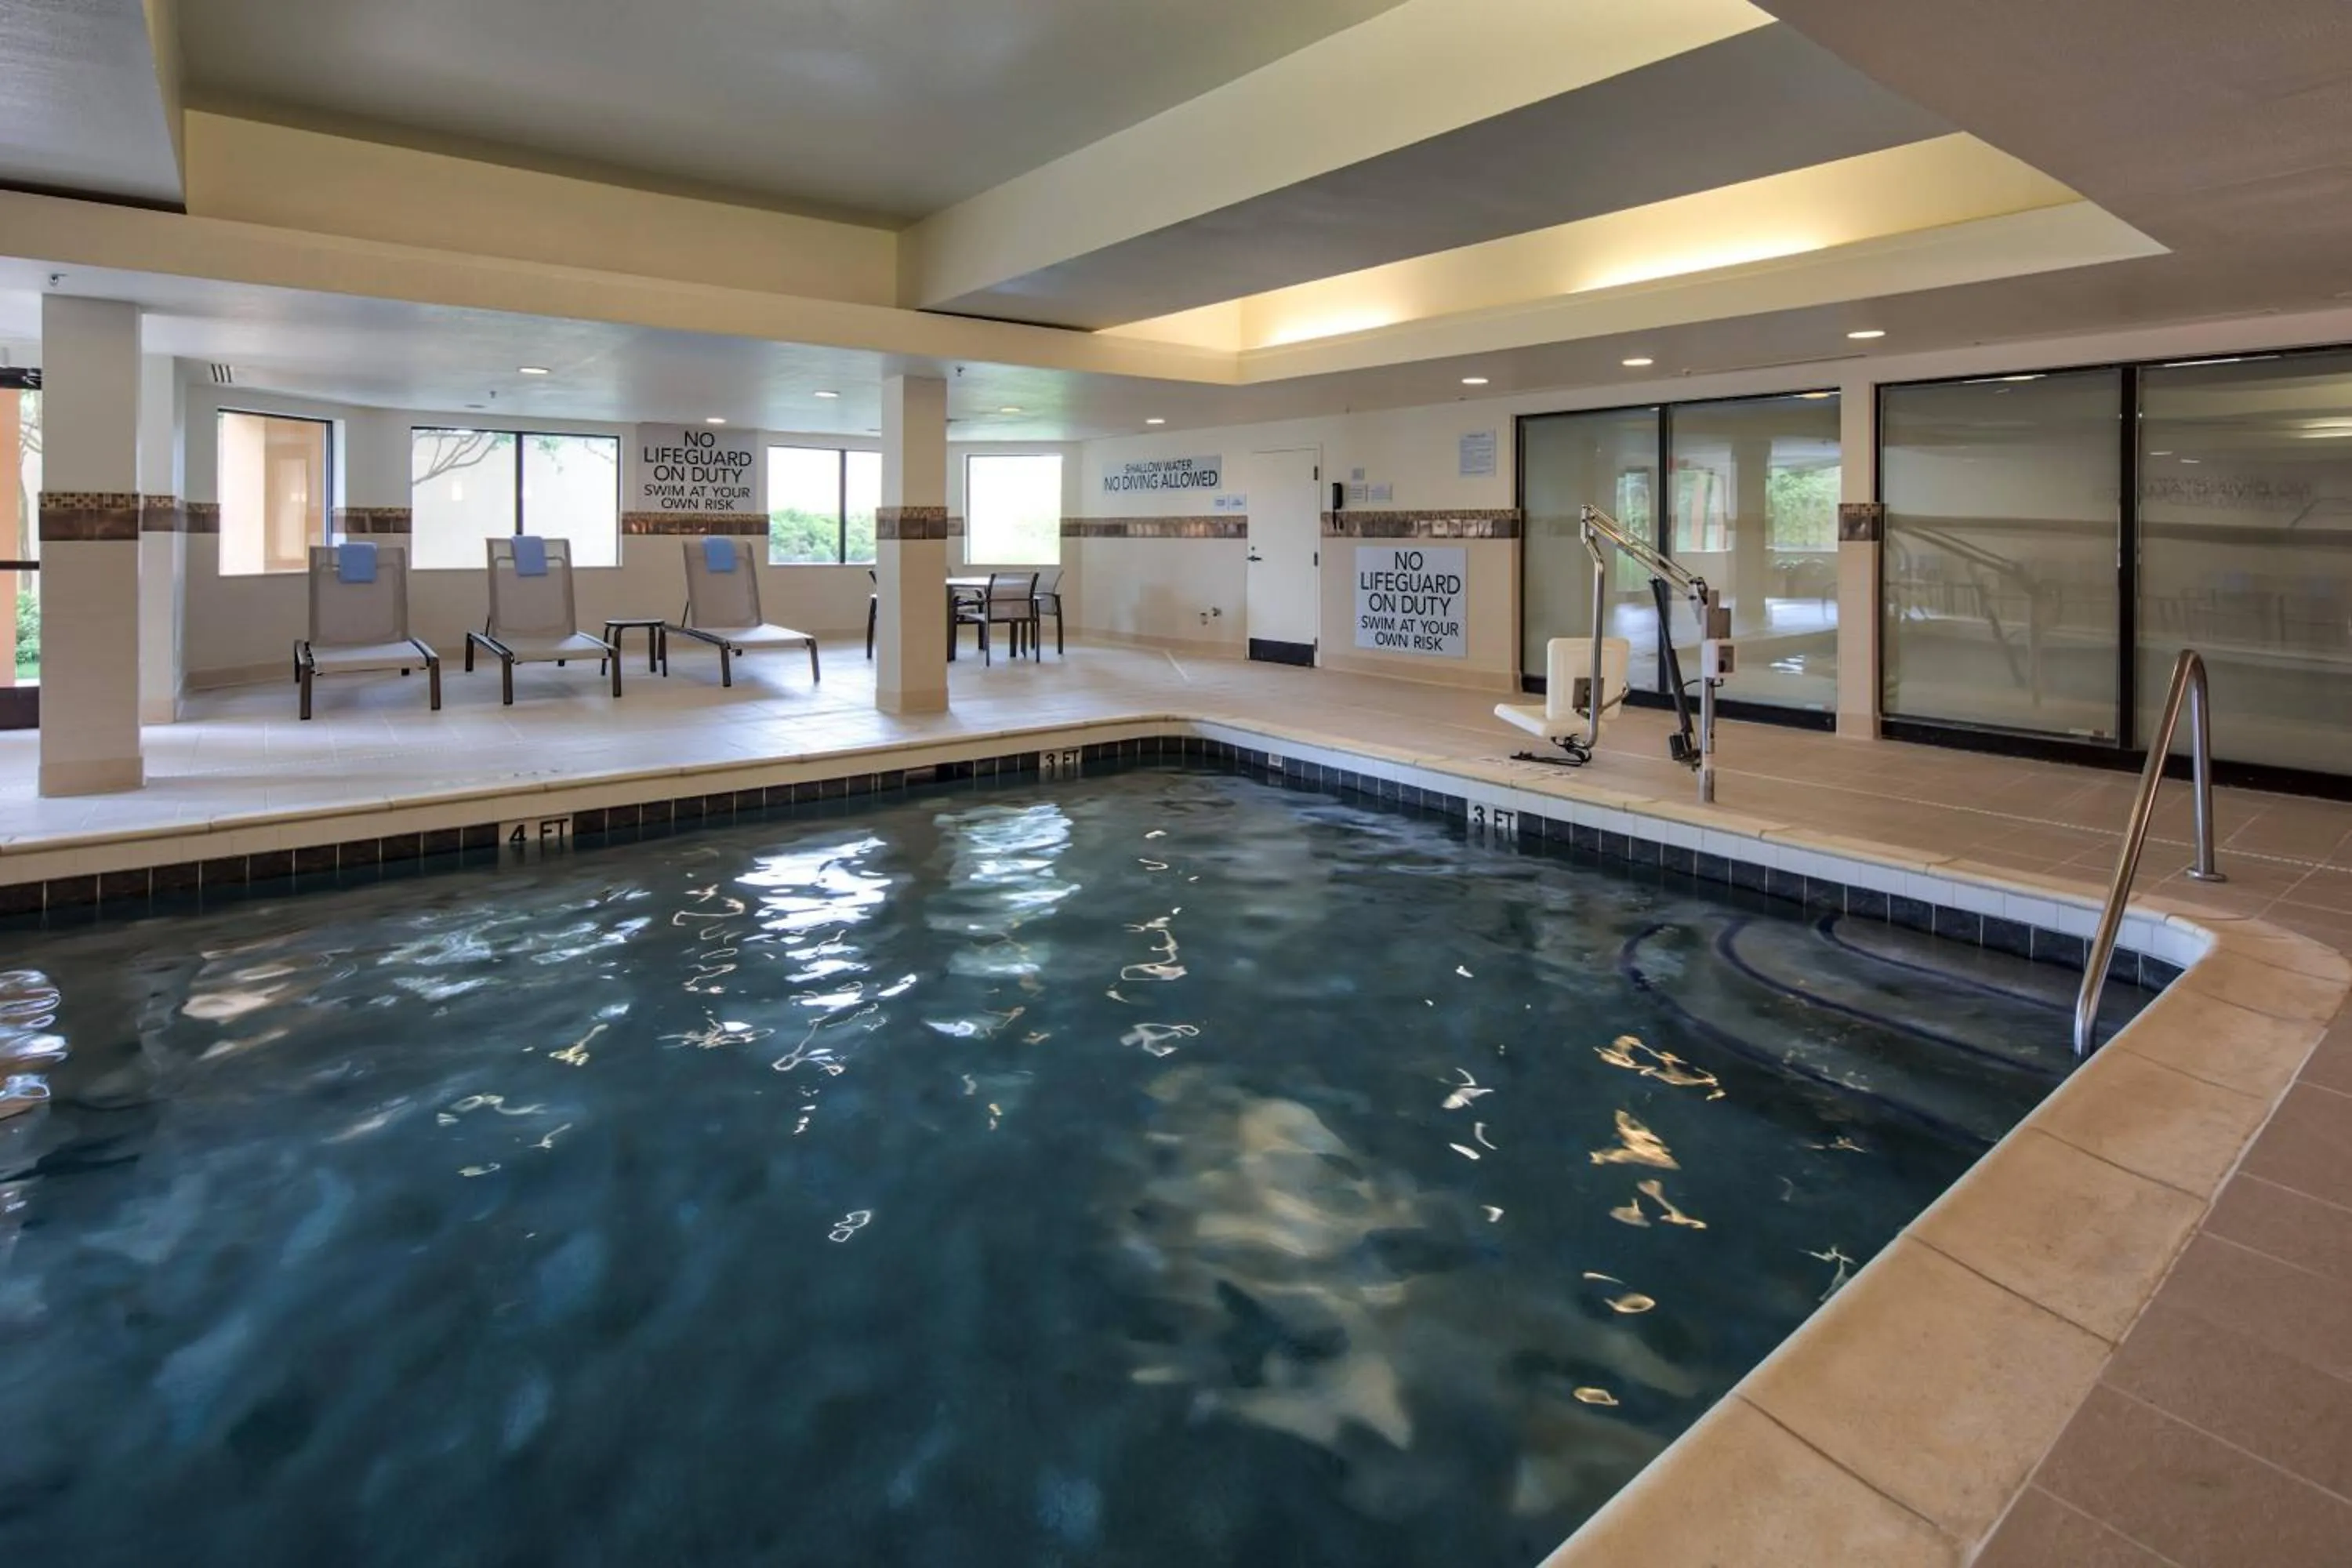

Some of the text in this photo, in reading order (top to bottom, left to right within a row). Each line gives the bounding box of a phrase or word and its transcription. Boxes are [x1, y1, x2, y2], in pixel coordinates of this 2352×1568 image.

[684, 430, 715, 448] NO
[644, 446, 753, 466] LIFEGUARD
[654, 465, 743, 483] ON DUTY
[1123, 459, 1192, 474] SHALLOW WATER
[1104, 470, 1218, 492] NO DIVING ALLOWED
[644, 485, 750, 499] SWIM AT YOUR
[661, 497, 735, 510] OWN RISK
[1395, 551, 1424, 571] NO
[1360, 572, 1461, 594] LIFEGUARD
[1369, 593, 1451, 616] ON DUTY
[1361, 615, 1459, 637] SWIM AT YOUR
[1374, 632, 1443, 652] OWN RISK
[1045, 750, 1080, 768] 3 FT
[1474, 804, 1515, 829] 3 FT
[509, 818, 569, 841] 4 FT
